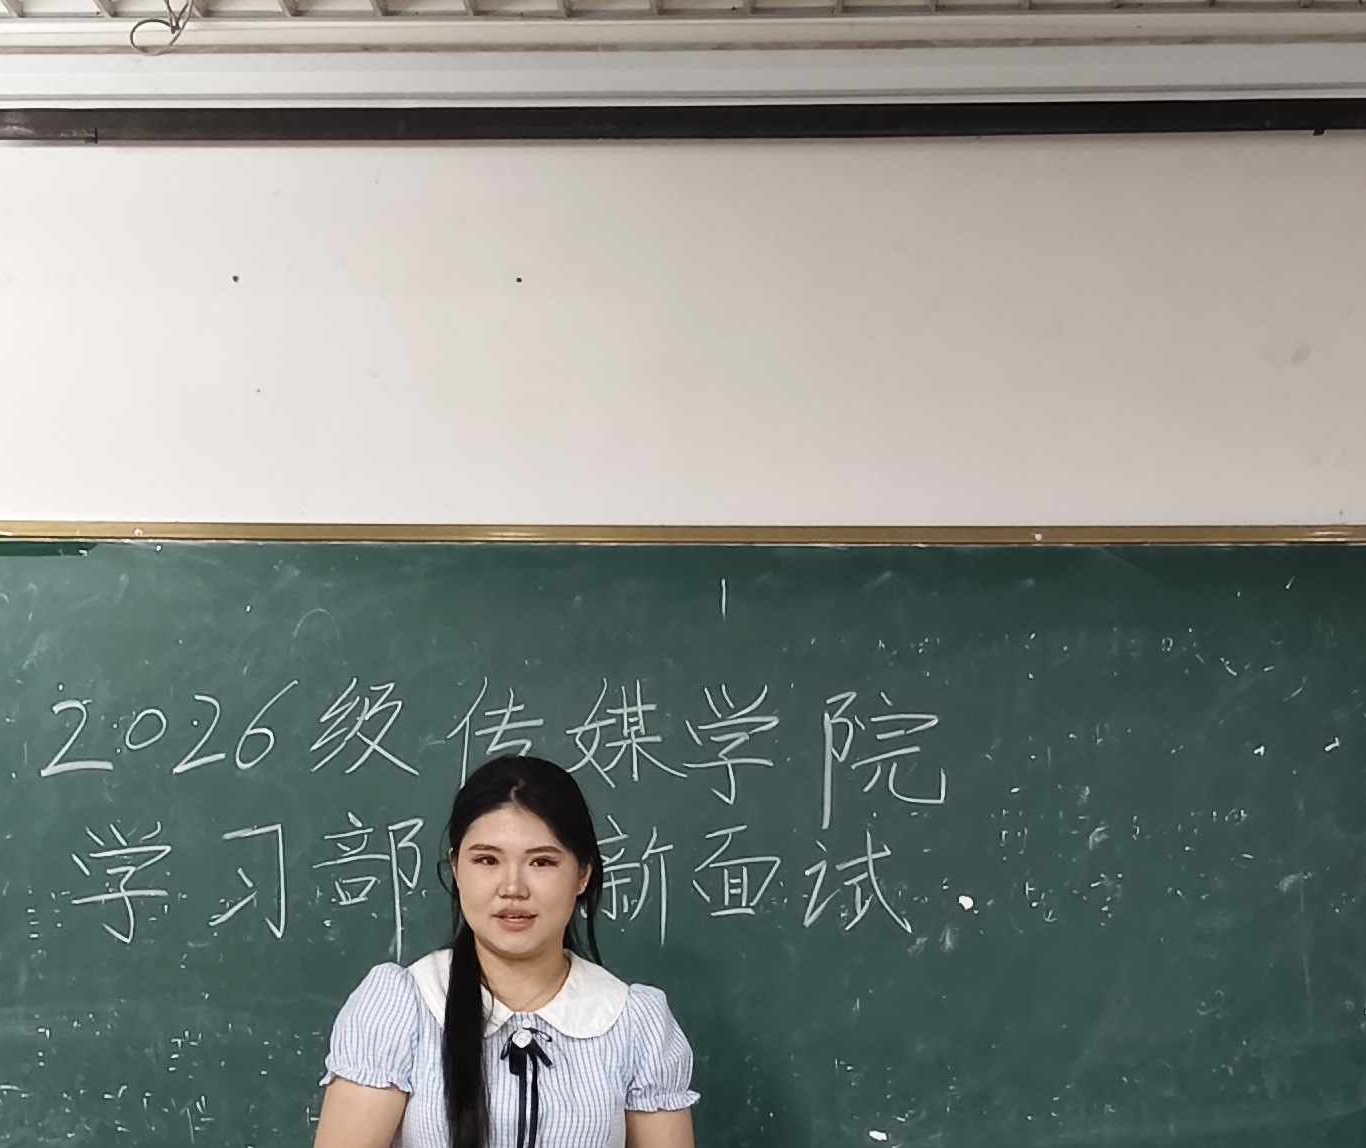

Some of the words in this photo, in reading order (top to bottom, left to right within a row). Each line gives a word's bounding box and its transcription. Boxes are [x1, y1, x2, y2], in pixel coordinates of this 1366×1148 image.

[72, 811, 913, 964] 学习部新面试
